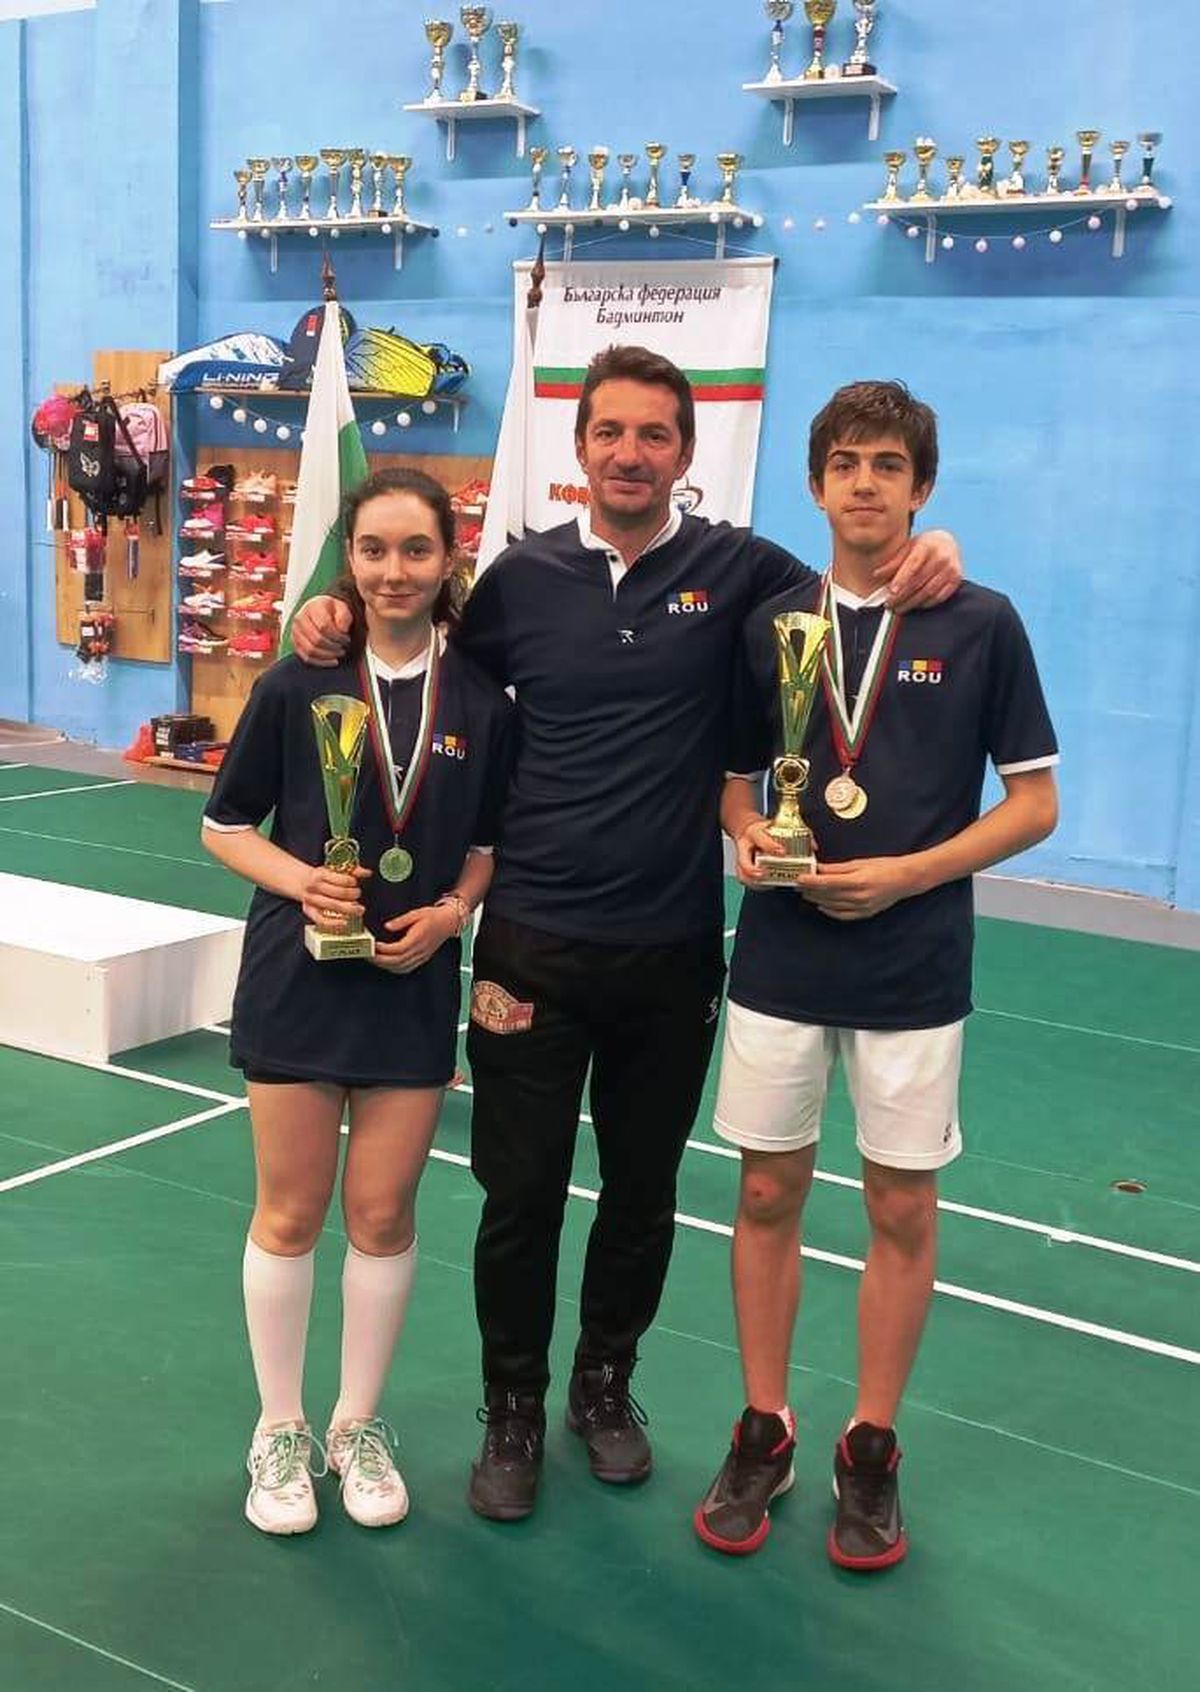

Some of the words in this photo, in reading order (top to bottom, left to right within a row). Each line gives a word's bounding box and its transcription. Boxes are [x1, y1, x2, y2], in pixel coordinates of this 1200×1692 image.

[563, 284, 633, 307] Българска
[637, 283, 722, 307] федерация
[596, 308, 685, 329] Бадминтон
[667, 602, 709, 614] ROU
[898, 670, 942, 684] ROU
[432, 742, 465, 760] ROU
